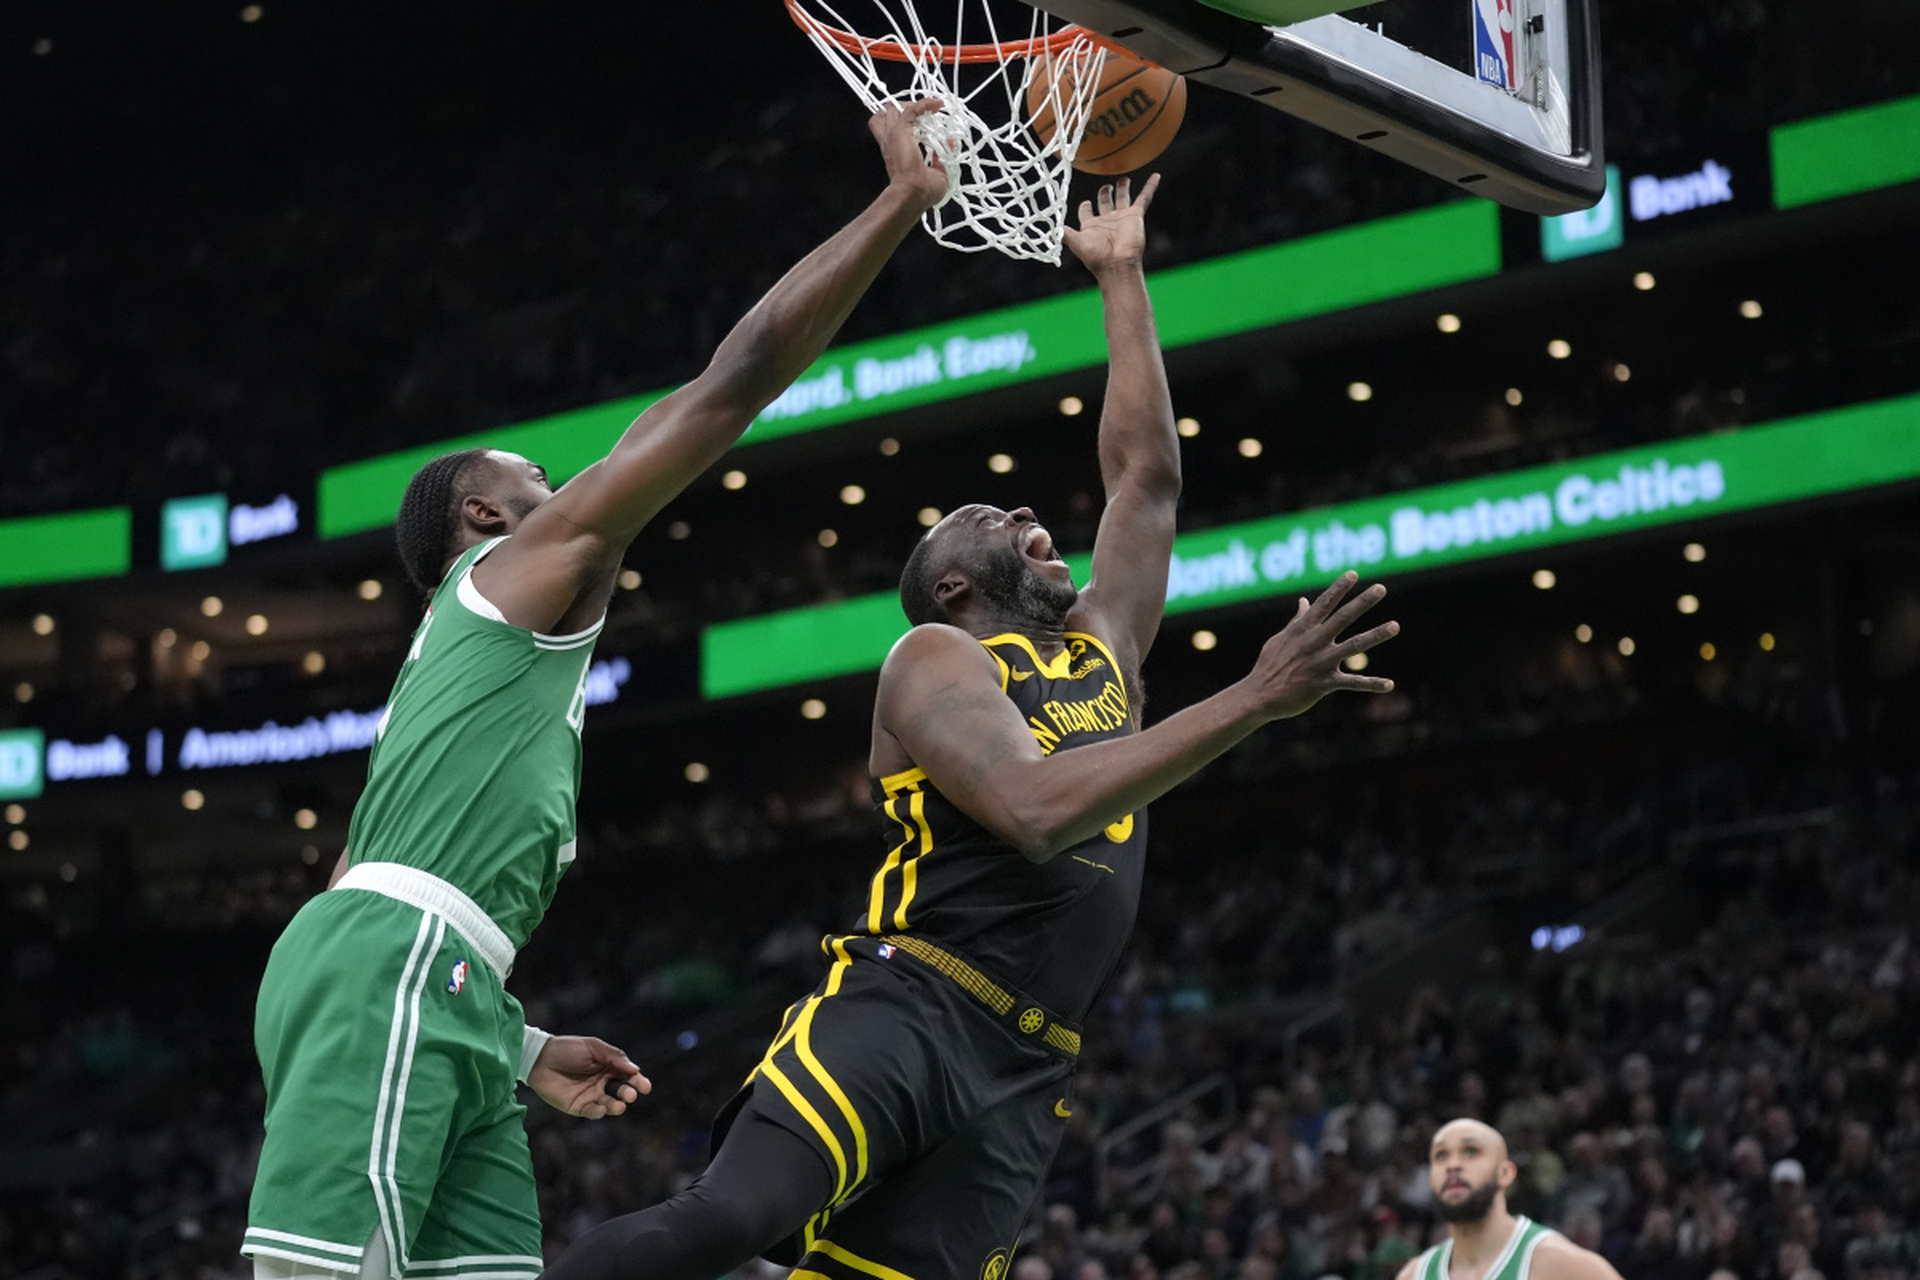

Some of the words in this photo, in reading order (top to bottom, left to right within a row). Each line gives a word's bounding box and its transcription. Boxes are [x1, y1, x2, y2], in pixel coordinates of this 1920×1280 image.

[1481, 52, 1502, 85] NBA
[1066, 87, 1156, 147] Wils
[1630, 159, 1734, 221] Bank
[854, 344, 942, 401] Bank
[943, 329, 1037, 380] Easy.
[228, 493, 300, 546] Bank
[1260, 526, 1309, 582] of
[1312, 520, 1387, 573] the
[1390, 492, 1552, 558] Boston
[1555, 457, 1725, 526] Celtics
[1043, 681, 1128, 736] FRANCISCO
[47, 734, 130, 781] Bank
